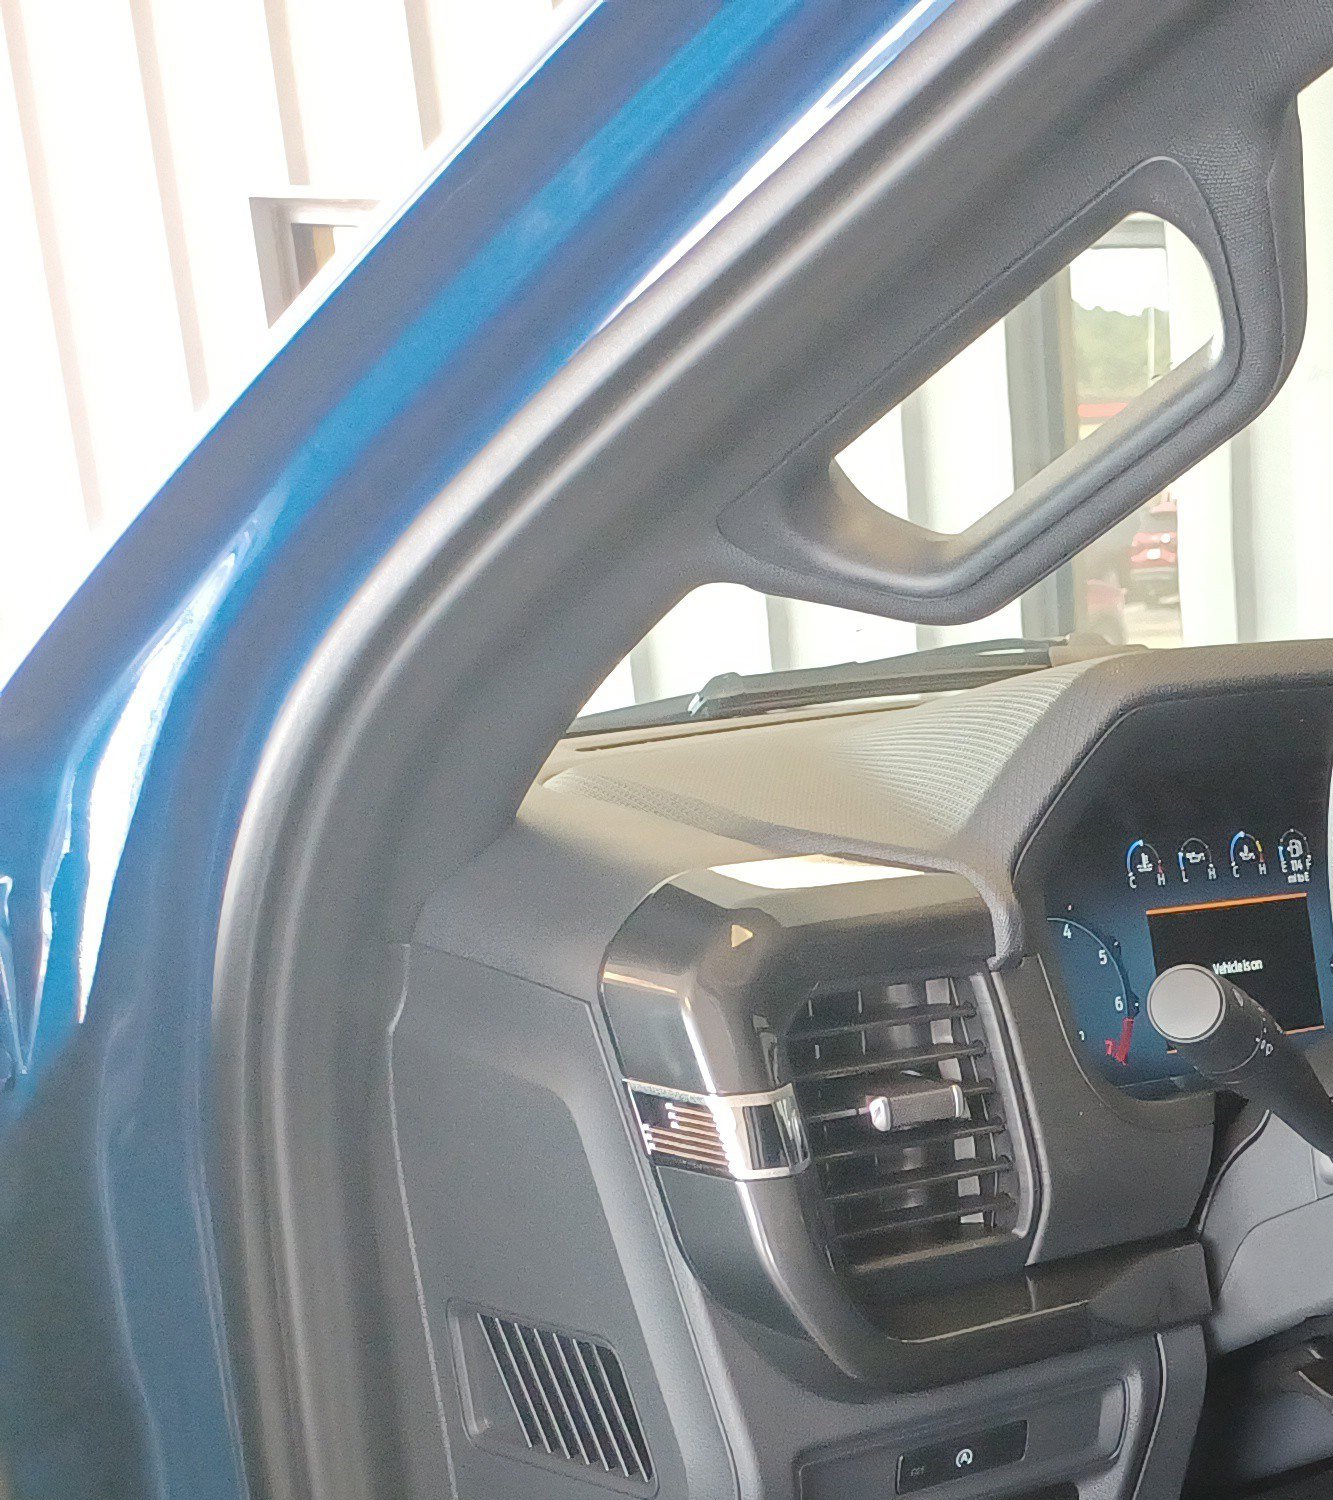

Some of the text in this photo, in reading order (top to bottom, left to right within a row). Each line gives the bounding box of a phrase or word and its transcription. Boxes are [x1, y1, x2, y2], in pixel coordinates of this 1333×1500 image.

[1207, 867, 1217, 880] H
[1232, 865, 1240, 878] C
[1258, 863, 1267, 875] H
[1129, 876, 1137, 889] C
[1157, 873, 1166, 886] H
[1063, 923, 1072, 939] 4
[1098, 949, 1107, 965] 5
[1212, 960, 1243, 975] Vehicle
[1114, 995, 1124, 1012] 6
